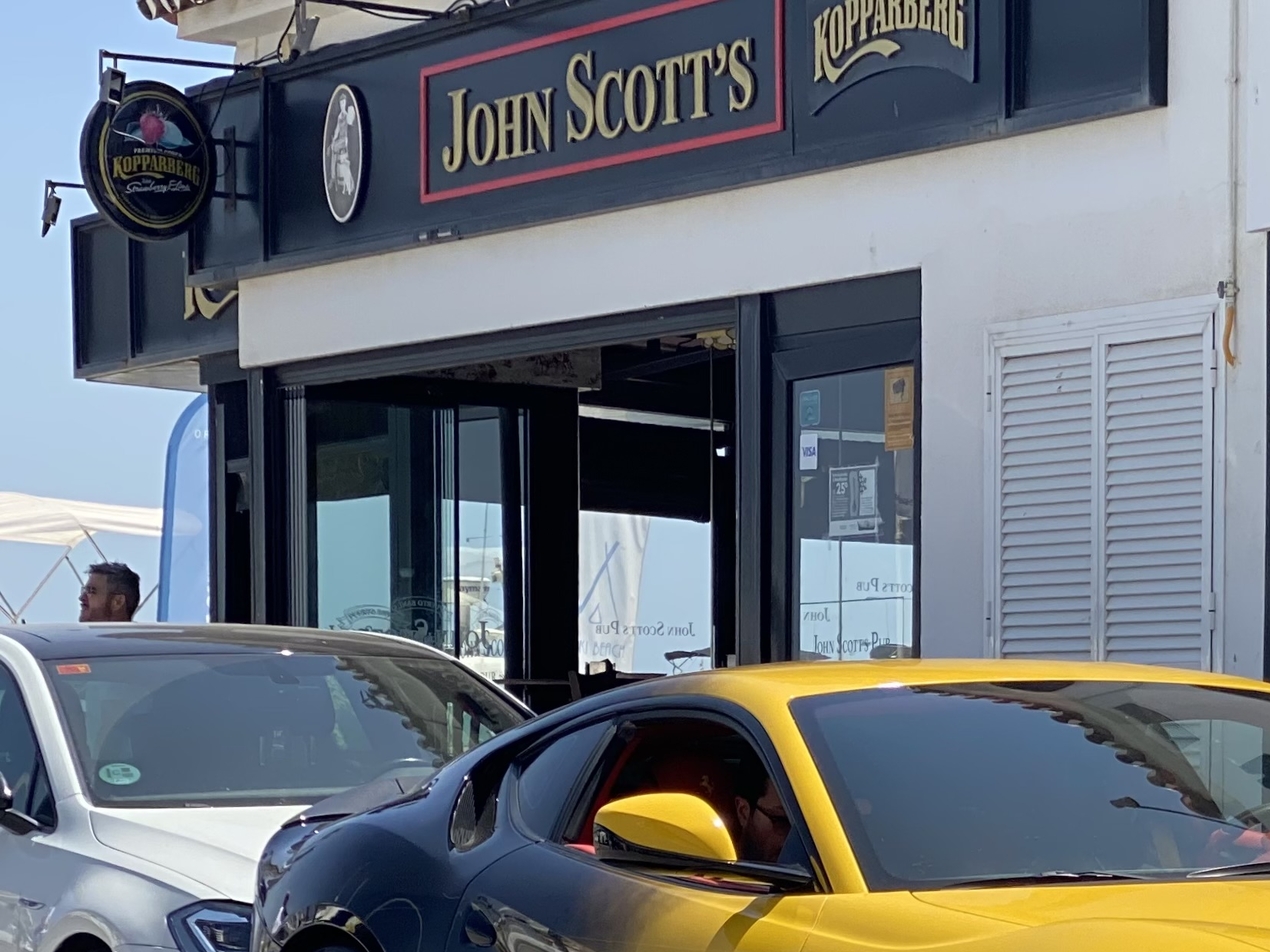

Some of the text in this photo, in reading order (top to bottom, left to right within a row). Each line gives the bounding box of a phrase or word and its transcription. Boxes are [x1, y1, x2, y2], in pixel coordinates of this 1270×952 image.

[812, 0, 966, 84] KOPPARBERG
[441, 37, 756, 173] JOHN SCOTT'S
[112, 154, 200, 186] KOPPARBERG
[801, 446, 816, 457] VISA
[813, 634, 835, 654] JOHN
